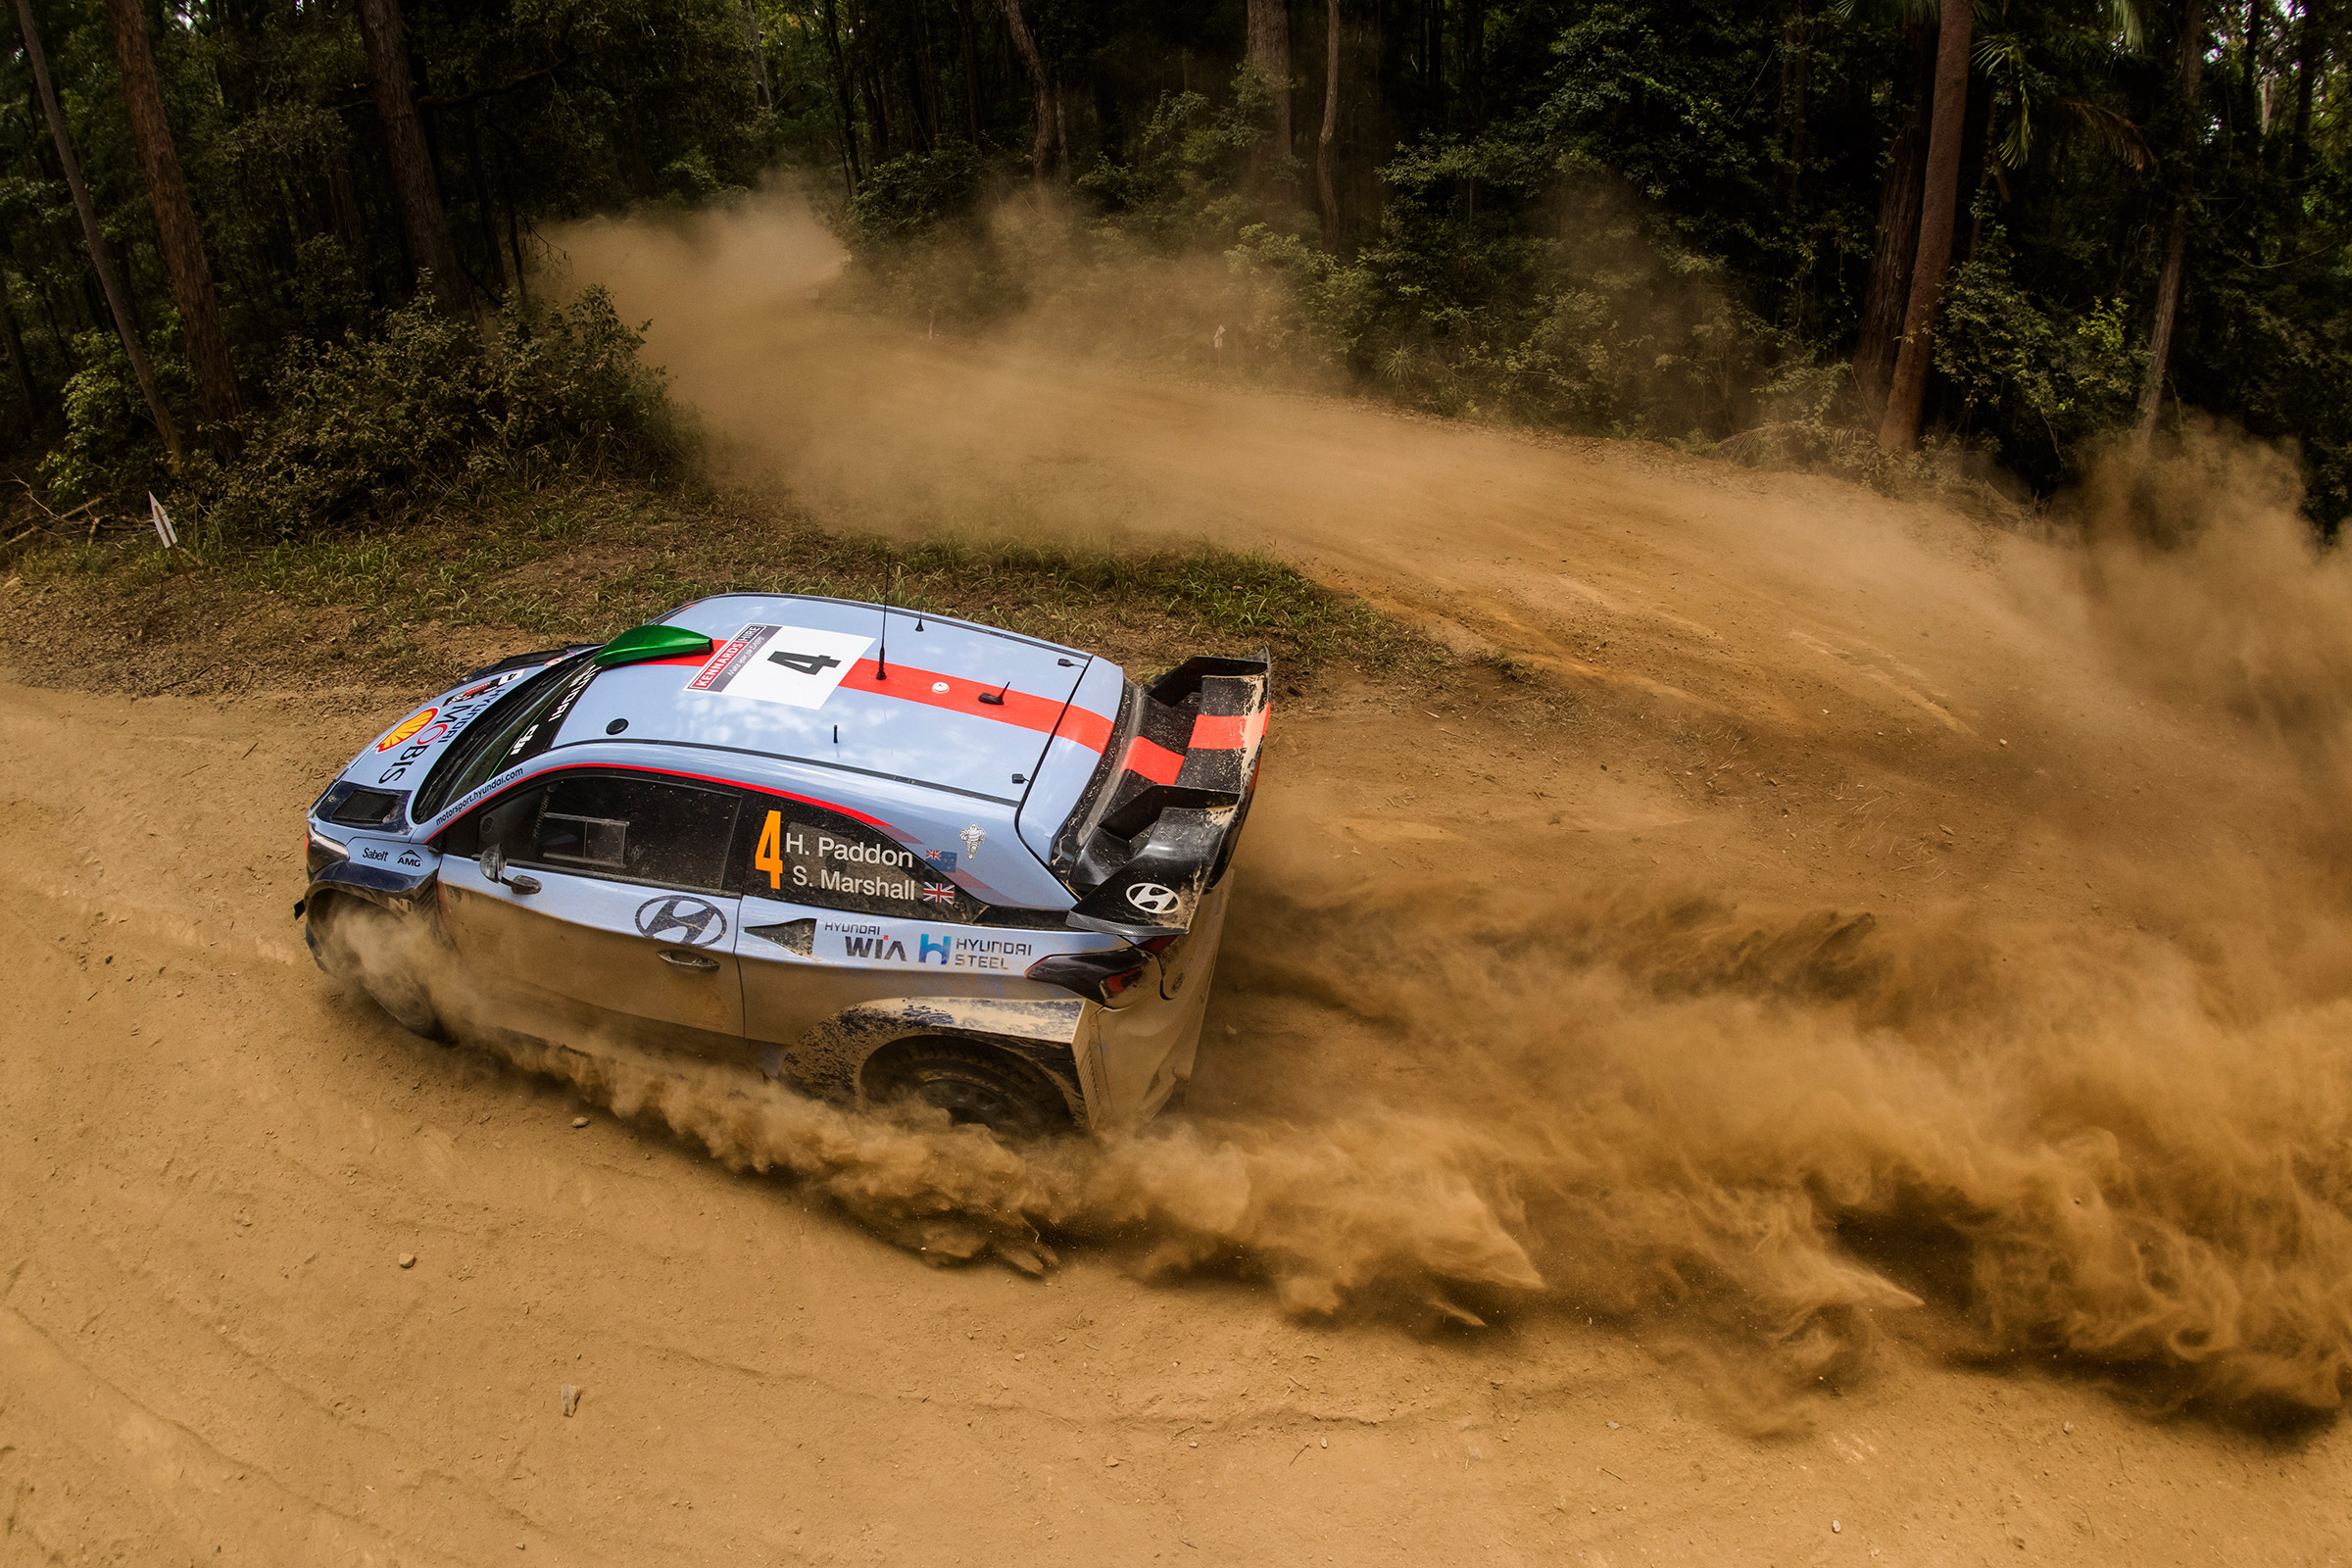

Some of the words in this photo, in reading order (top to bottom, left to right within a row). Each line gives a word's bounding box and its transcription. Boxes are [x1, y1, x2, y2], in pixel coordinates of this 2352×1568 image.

[696, 642, 744, 686] KENNARDS
[737, 626, 761, 642] HIRE
[766, 650, 842, 676] 4
[438, 688, 507, 744] HYUNDAI
[378, 703, 474, 784] MOBIS
[435, 767, 524, 826] motorsport.hyundai.com
[362, 847, 389, 862] Sabelt
[397, 857, 421, 867] AMG
[755, 809, 784, 890] 4
[785, 832, 810, 856] H.
[818, 836, 913, 868] Paddon
[792, 864, 813, 887] S.
[820, 868, 915, 901] Marshall
[824, 921, 881, 936] HYUNDAI
[845, 934, 907, 962] WIA
[955, 955, 1009, 970] STEEL
[956, 938, 1032, 956] HYUNDAI
